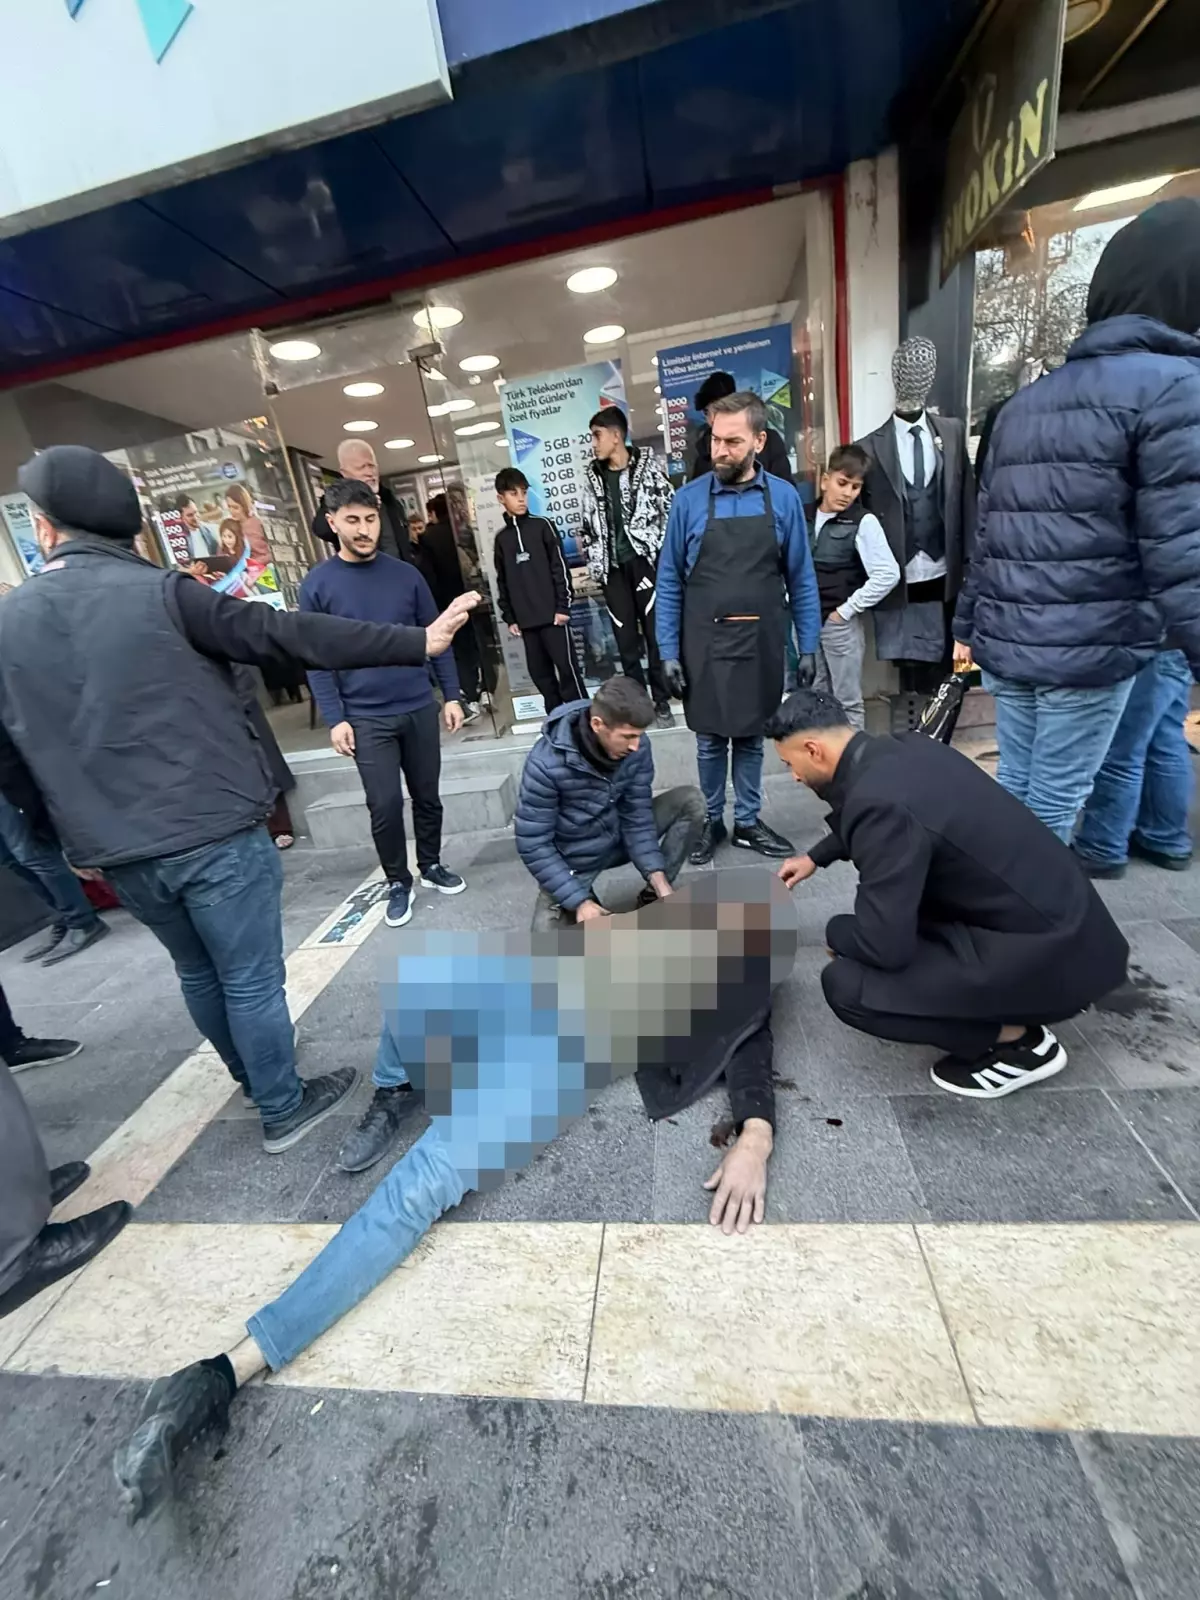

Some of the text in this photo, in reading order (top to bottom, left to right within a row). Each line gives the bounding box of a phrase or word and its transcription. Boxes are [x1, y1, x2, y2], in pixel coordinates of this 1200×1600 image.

[505, 377, 583, 401] Türk Telekom'dan
[539, 390, 575, 404] Günler'e
[667, 397, 688, 407] 1000
[509, 405, 561, 423] özel fiyatlar
[669, 412, 685, 422] 500
[670, 426, 686, 436] 200
[544, 441, 552, 452] 5
[553, 437, 570, 449] GB
[672, 439, 687, 449] 100
[541, 456, 554, 469] 10
[555, 453, 572, 466] GB
[541, 472, 557, 483] 20
[558, 468, 575, 480] GB
[544, 483, 577, 499] 30 GB
[546, 498, 579, 513] 40 GB
[565, 512, 581, 524] GB
